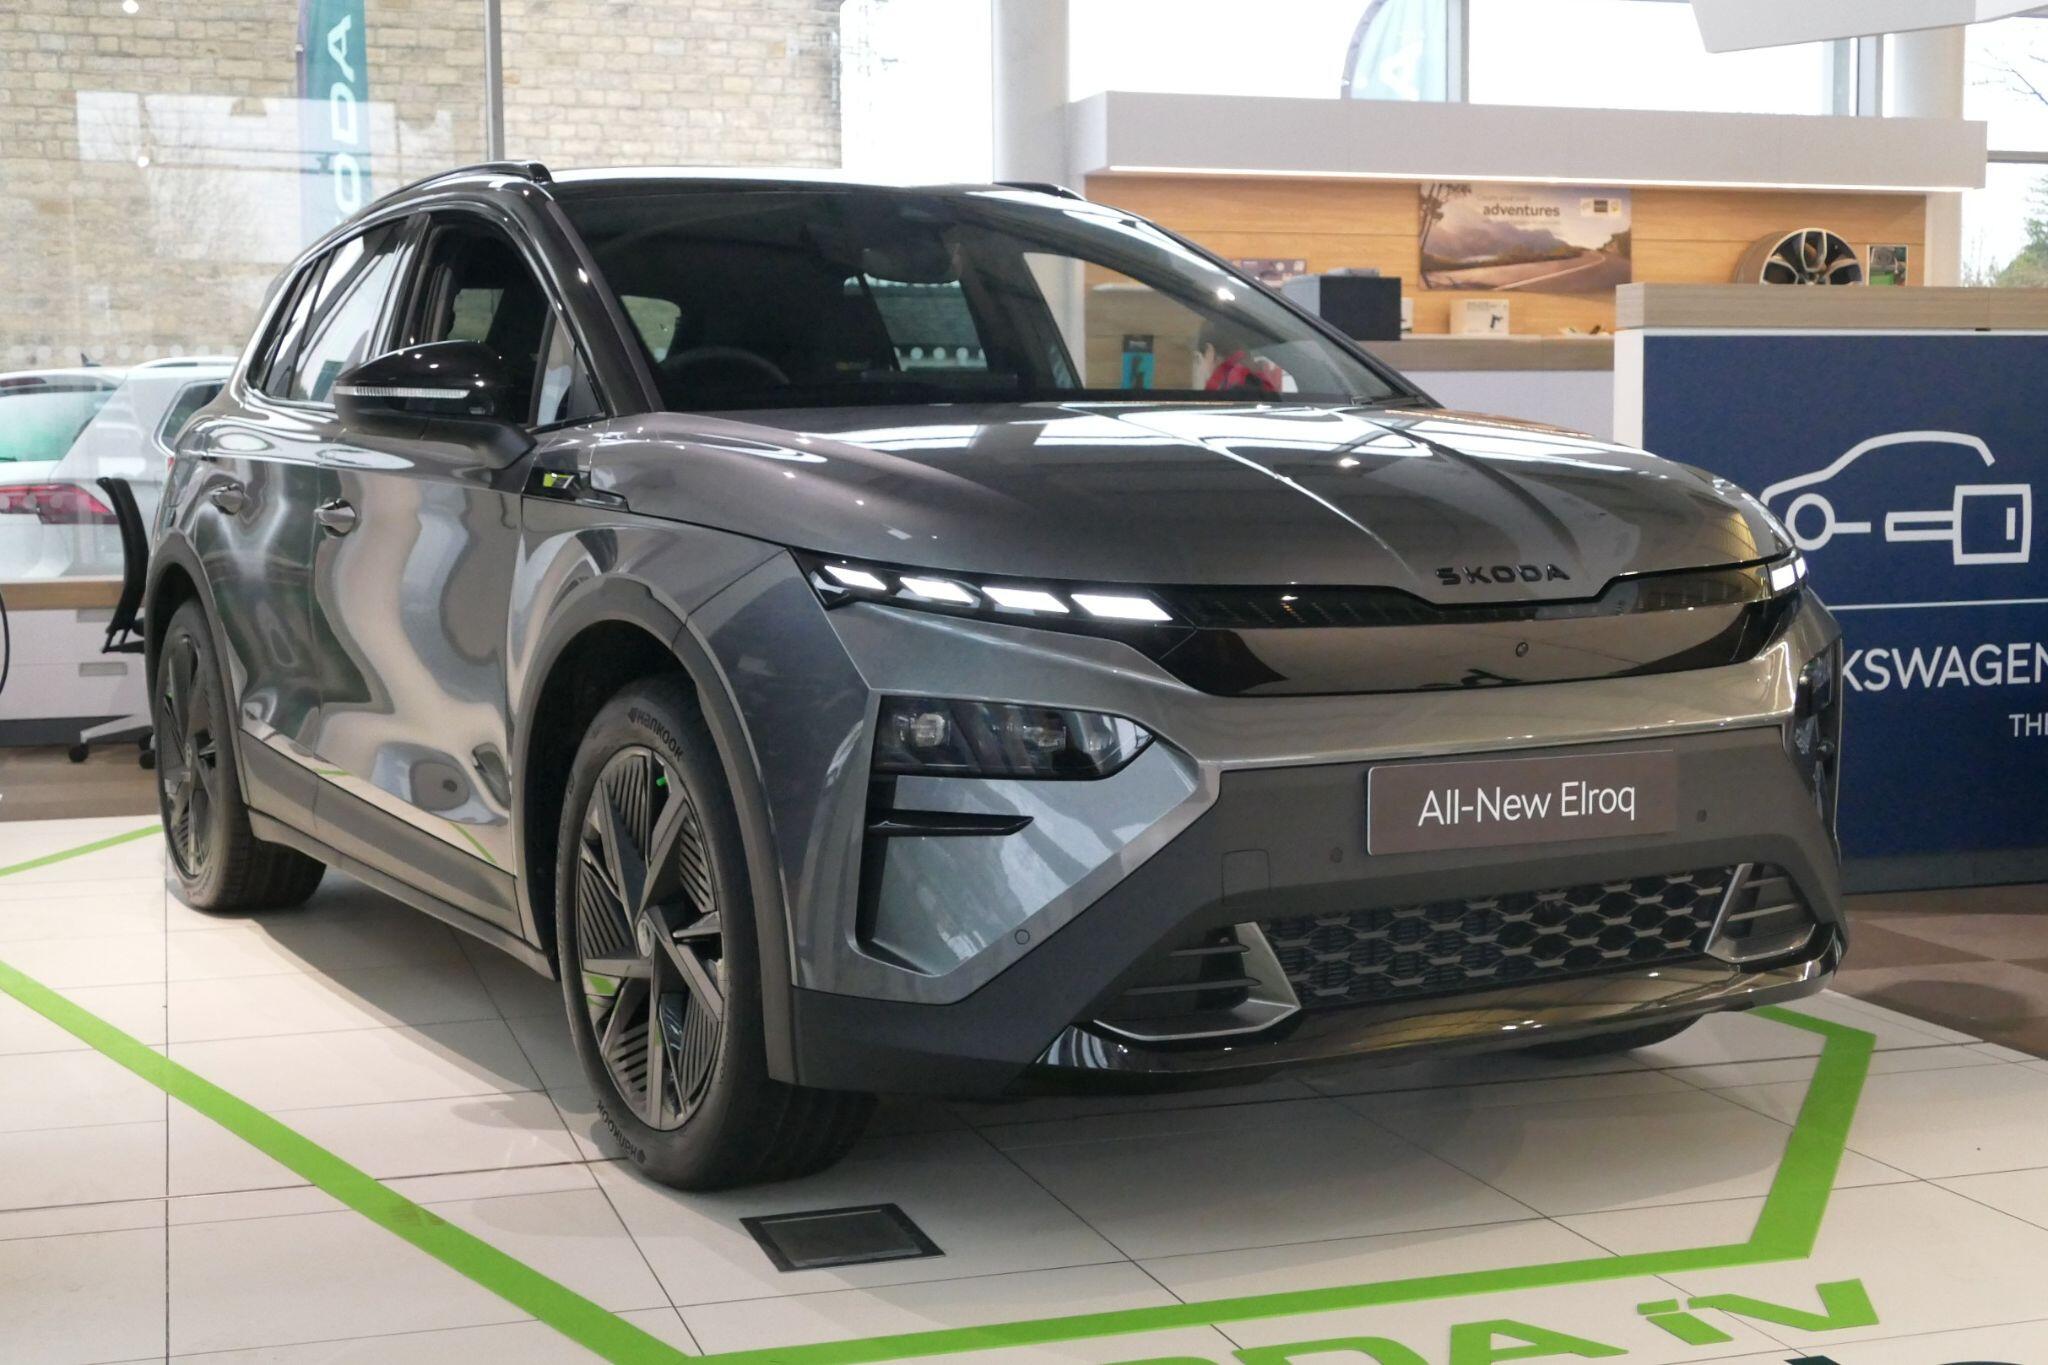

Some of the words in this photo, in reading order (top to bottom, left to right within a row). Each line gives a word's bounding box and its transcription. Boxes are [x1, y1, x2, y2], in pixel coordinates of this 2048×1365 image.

[327, 14, 361, 224] ODA
[1482, 204, 1561, 218] adventures
[1435, 563, 1571, 586] SKODA
[2008, 712, 2048, 738] TH
[1417, 786, 1552, 827] All-New
[1561, 780, 1636, 821] Elroq
[1636, 1278, 1880, 1346] iV
